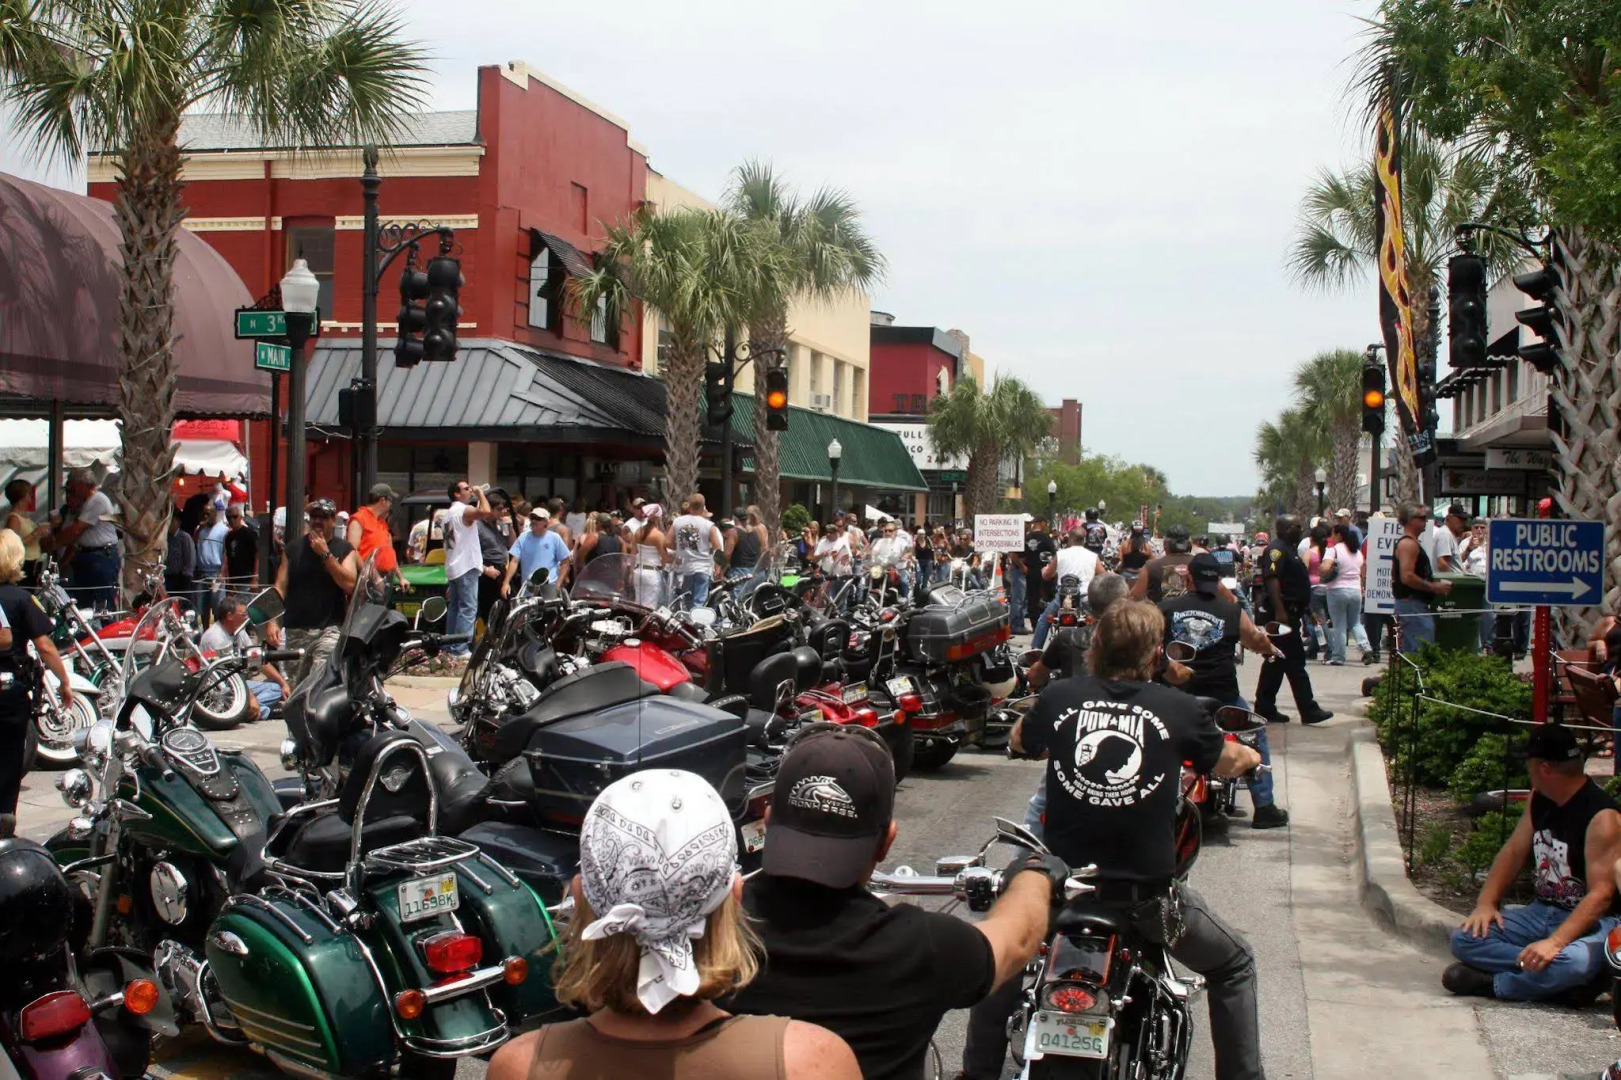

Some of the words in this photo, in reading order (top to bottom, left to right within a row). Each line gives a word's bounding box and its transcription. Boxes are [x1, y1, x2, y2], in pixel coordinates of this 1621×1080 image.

[250, 319, 256, 329] N
[267, 347, 286, 365] MAIN
[979, 518, 987, 526] NO
[988, 518, 1012, 526] PARKING
[1013, 518, 1019, 526] IN
[1383, 522, 1404, 535] FIE
[985, 540, 1022, 548] CROSSWALKS
[1516, 524, 1578, 548] PUBLIC
[1492, 548, 1600, 574] RESTROOMS
[1376, 567, 1390, 577] MOT
[1053, 707, 1078, 732] ALL
[1082, 700, 1128, 710] GAVE
[1131, 705, 1170, 741] SOME
[1075, 709, 1112, 742] POW
[1117, 714, 1144, 749] MIA
[1053, 760, 1085, 800] SOME
[1088, 795, 1135, 807] GAVE
[1139, 772, 1165, 800] ALL
[1072, 779, 1087, 791] HELP
[1087, 787, 1104, 798] BRING
[1120, 785, 1137, 796] HOME
[405, 893, 453, 914] 11698K
[1041, 1032, 1103, 1052] 04125G
